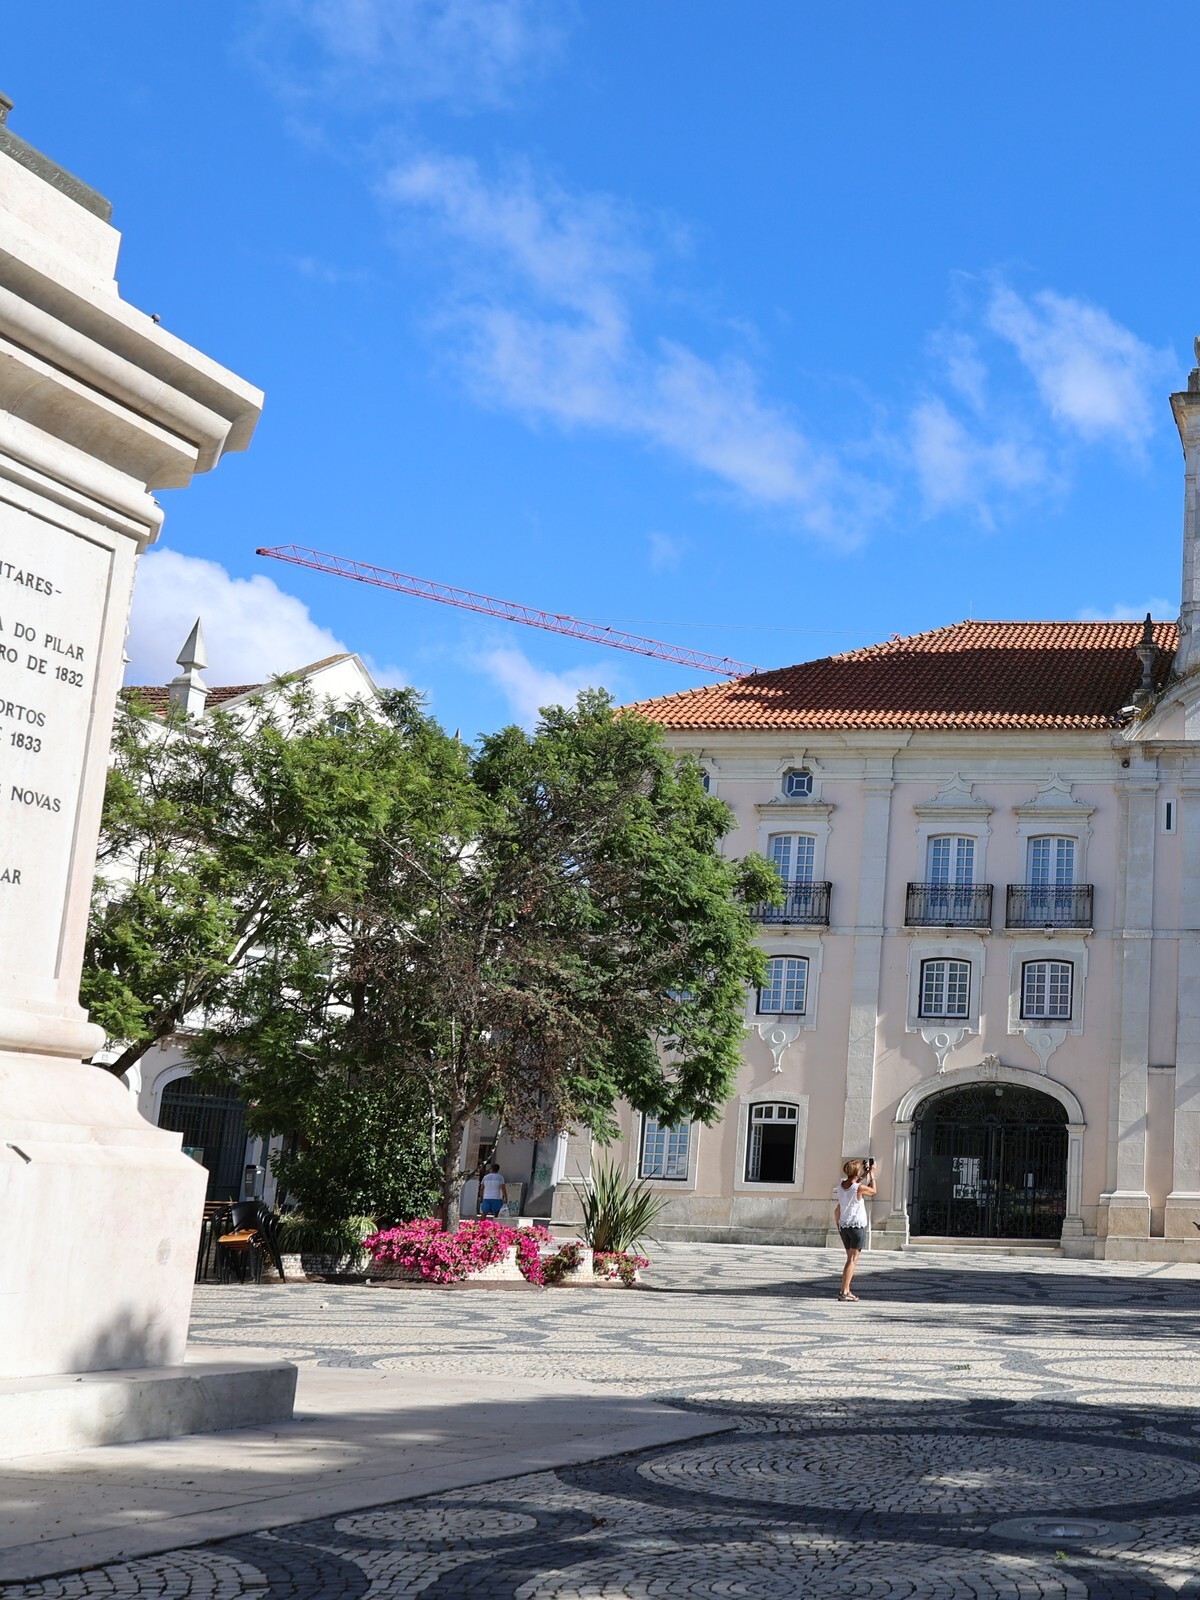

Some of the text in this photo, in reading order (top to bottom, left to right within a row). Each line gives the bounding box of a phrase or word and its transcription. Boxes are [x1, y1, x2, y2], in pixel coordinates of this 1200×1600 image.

[13, 622, 36, 642] DO
[44, 633, 84, 662] PILAR
[26, 655, 48, 675] DE
[55, 665, 84, 688] 1832
[10, 731, 42, 753] 1833
[10, 785, 62, 813] NOVAS
